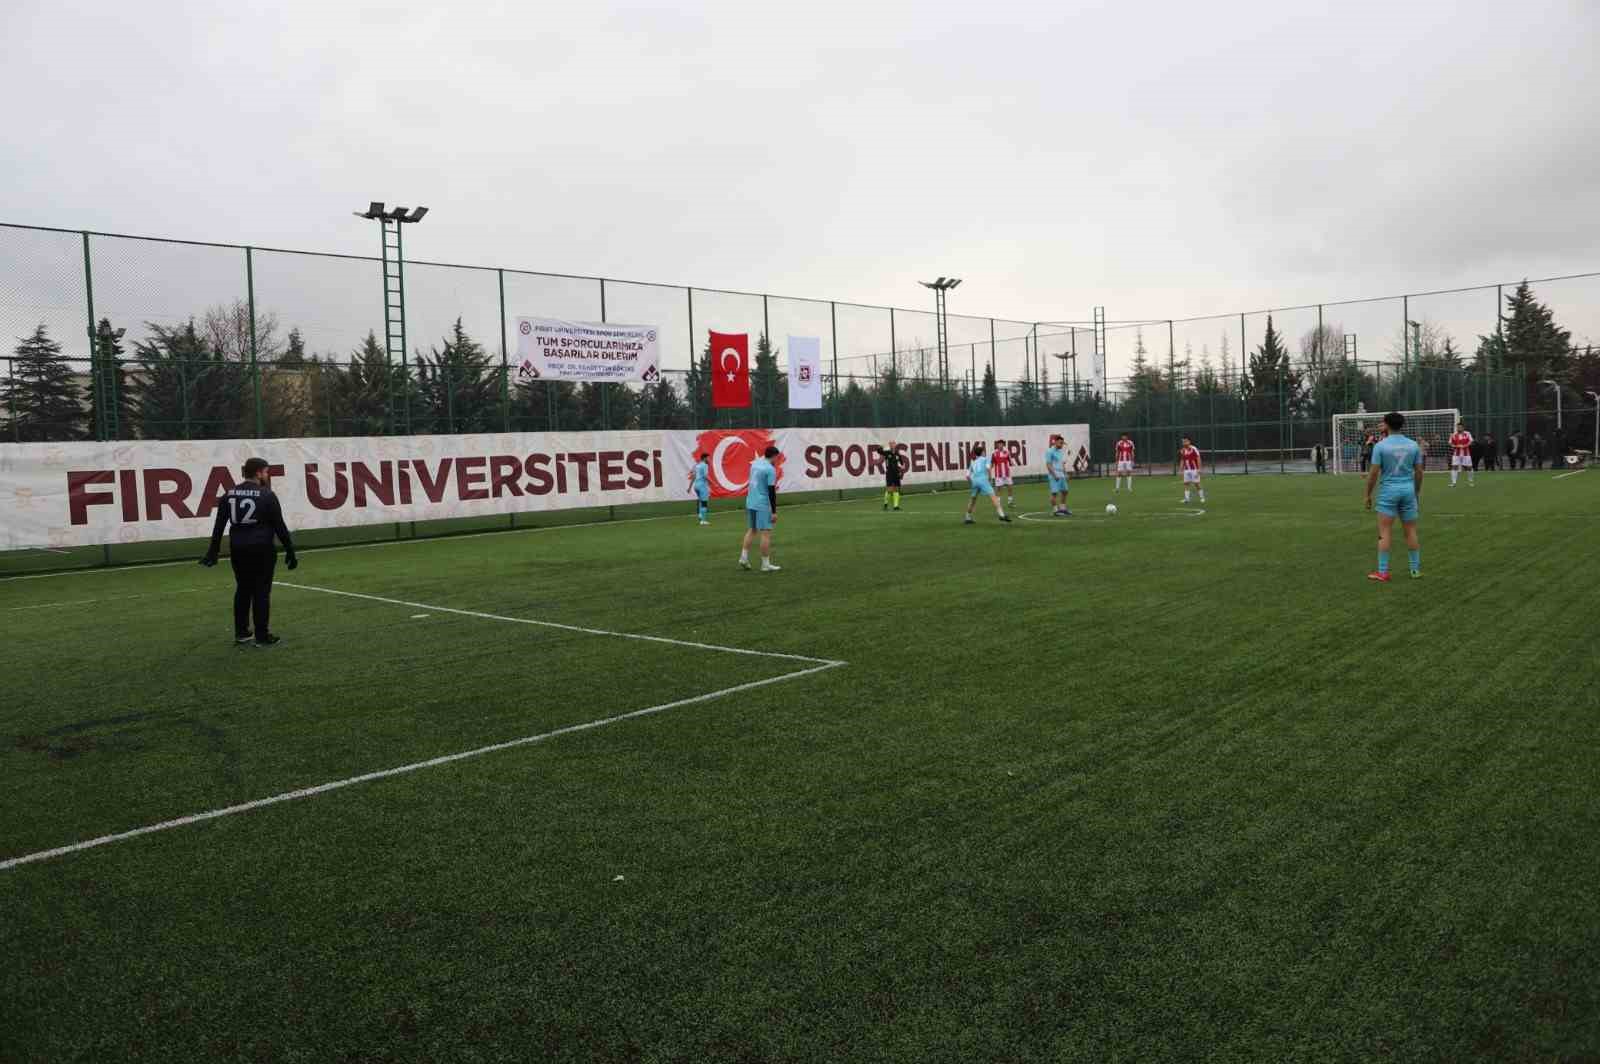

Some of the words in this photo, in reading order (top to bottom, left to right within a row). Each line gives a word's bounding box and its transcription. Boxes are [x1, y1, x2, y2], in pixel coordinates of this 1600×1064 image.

[1391, 449, 1409, 475] 7
[305, 450, 663, 510] ÜNİVERSİTESİ
[804, 444, 886, 478] SPOR
[228, 497, 257, 524] 12
